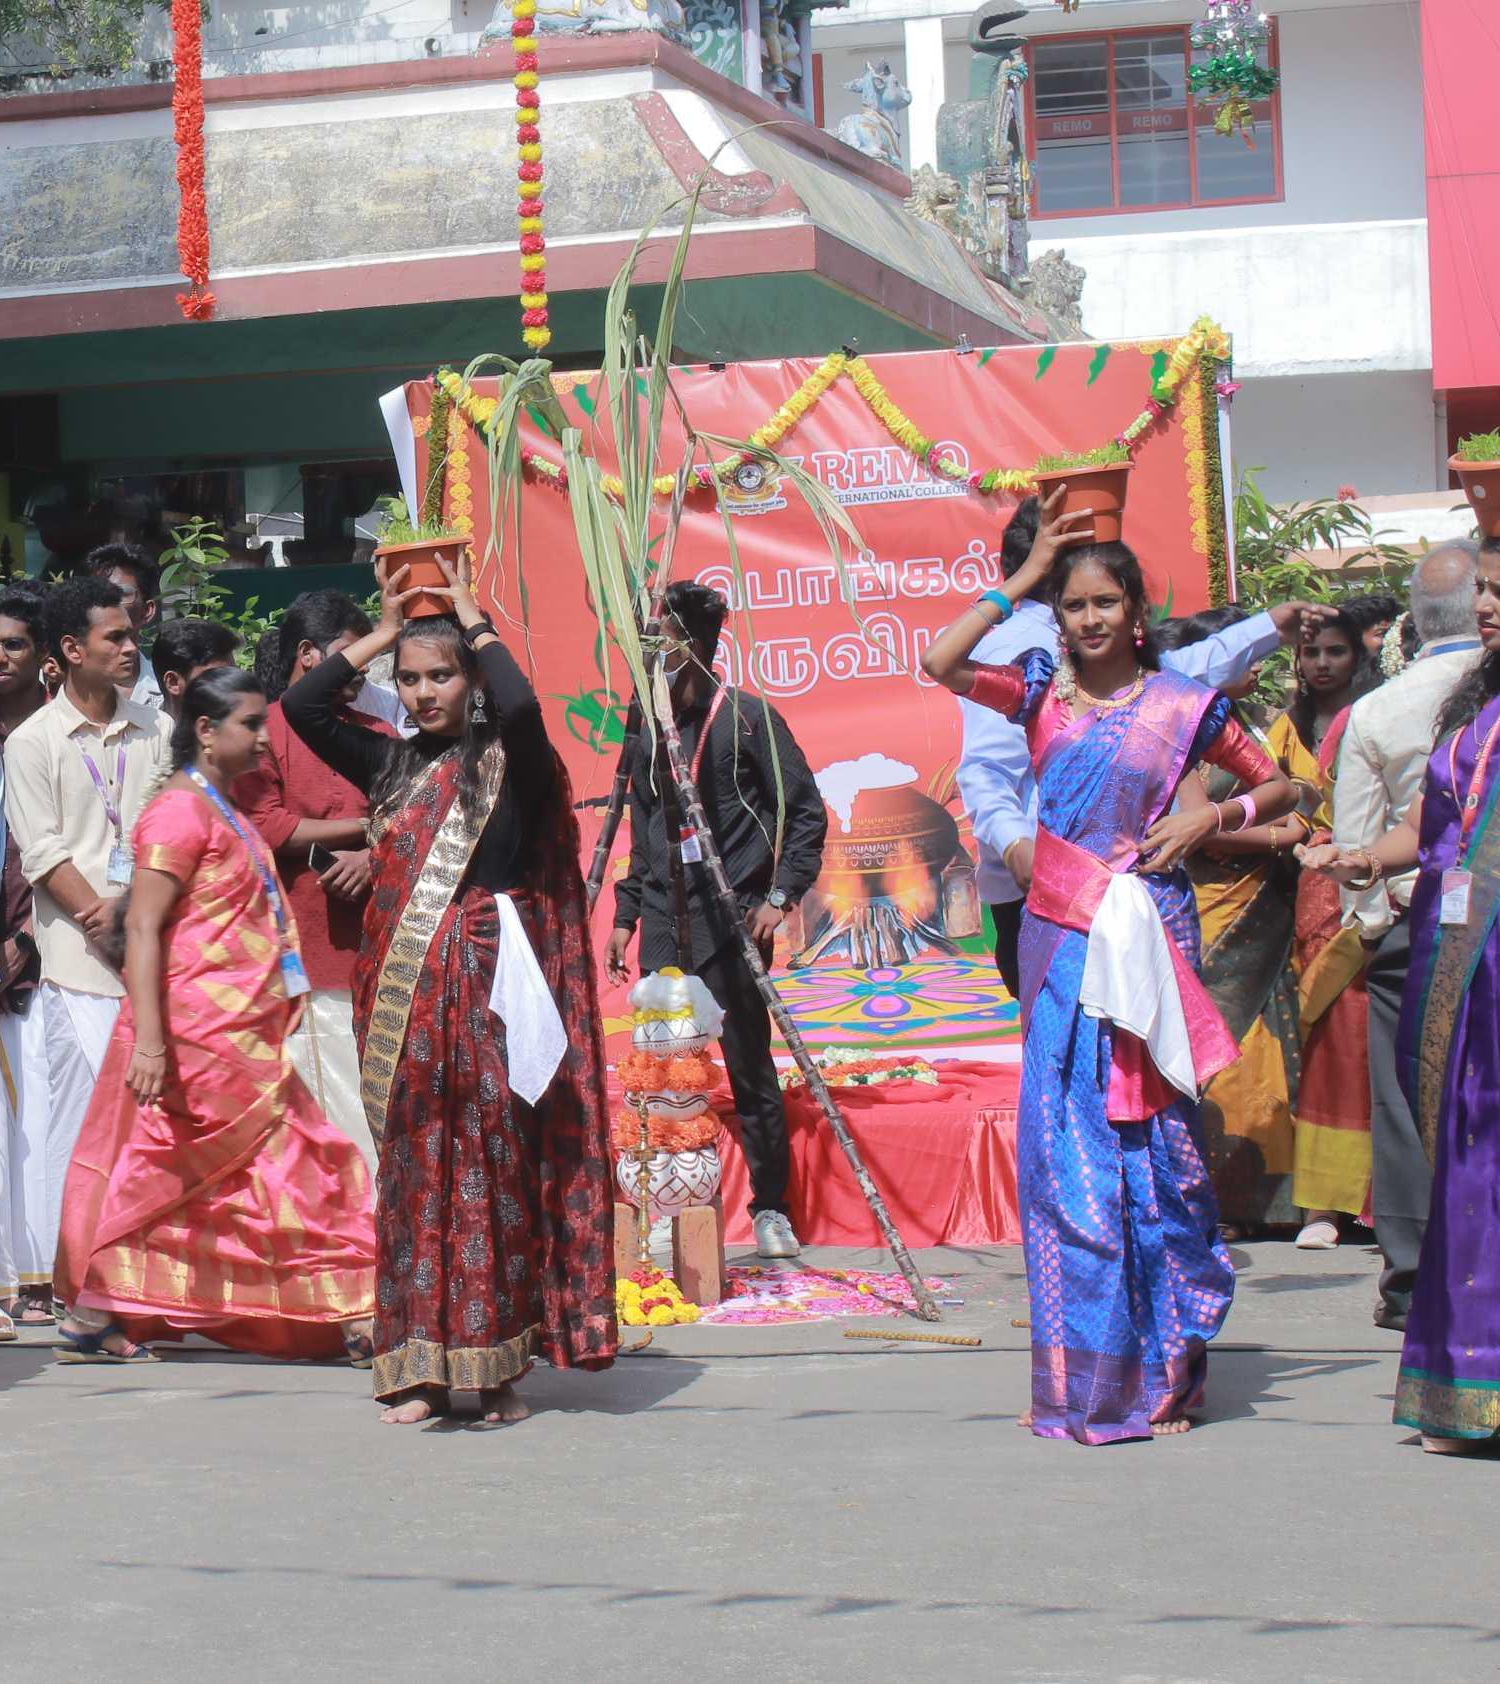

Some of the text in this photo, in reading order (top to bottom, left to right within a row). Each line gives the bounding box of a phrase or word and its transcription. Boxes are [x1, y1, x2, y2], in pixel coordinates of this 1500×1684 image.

[1053, 119, 1093, 134] REMO
[1132, 114, 1173, 129] REMO
[835, 487, 913, 504] ERNATIONAL
